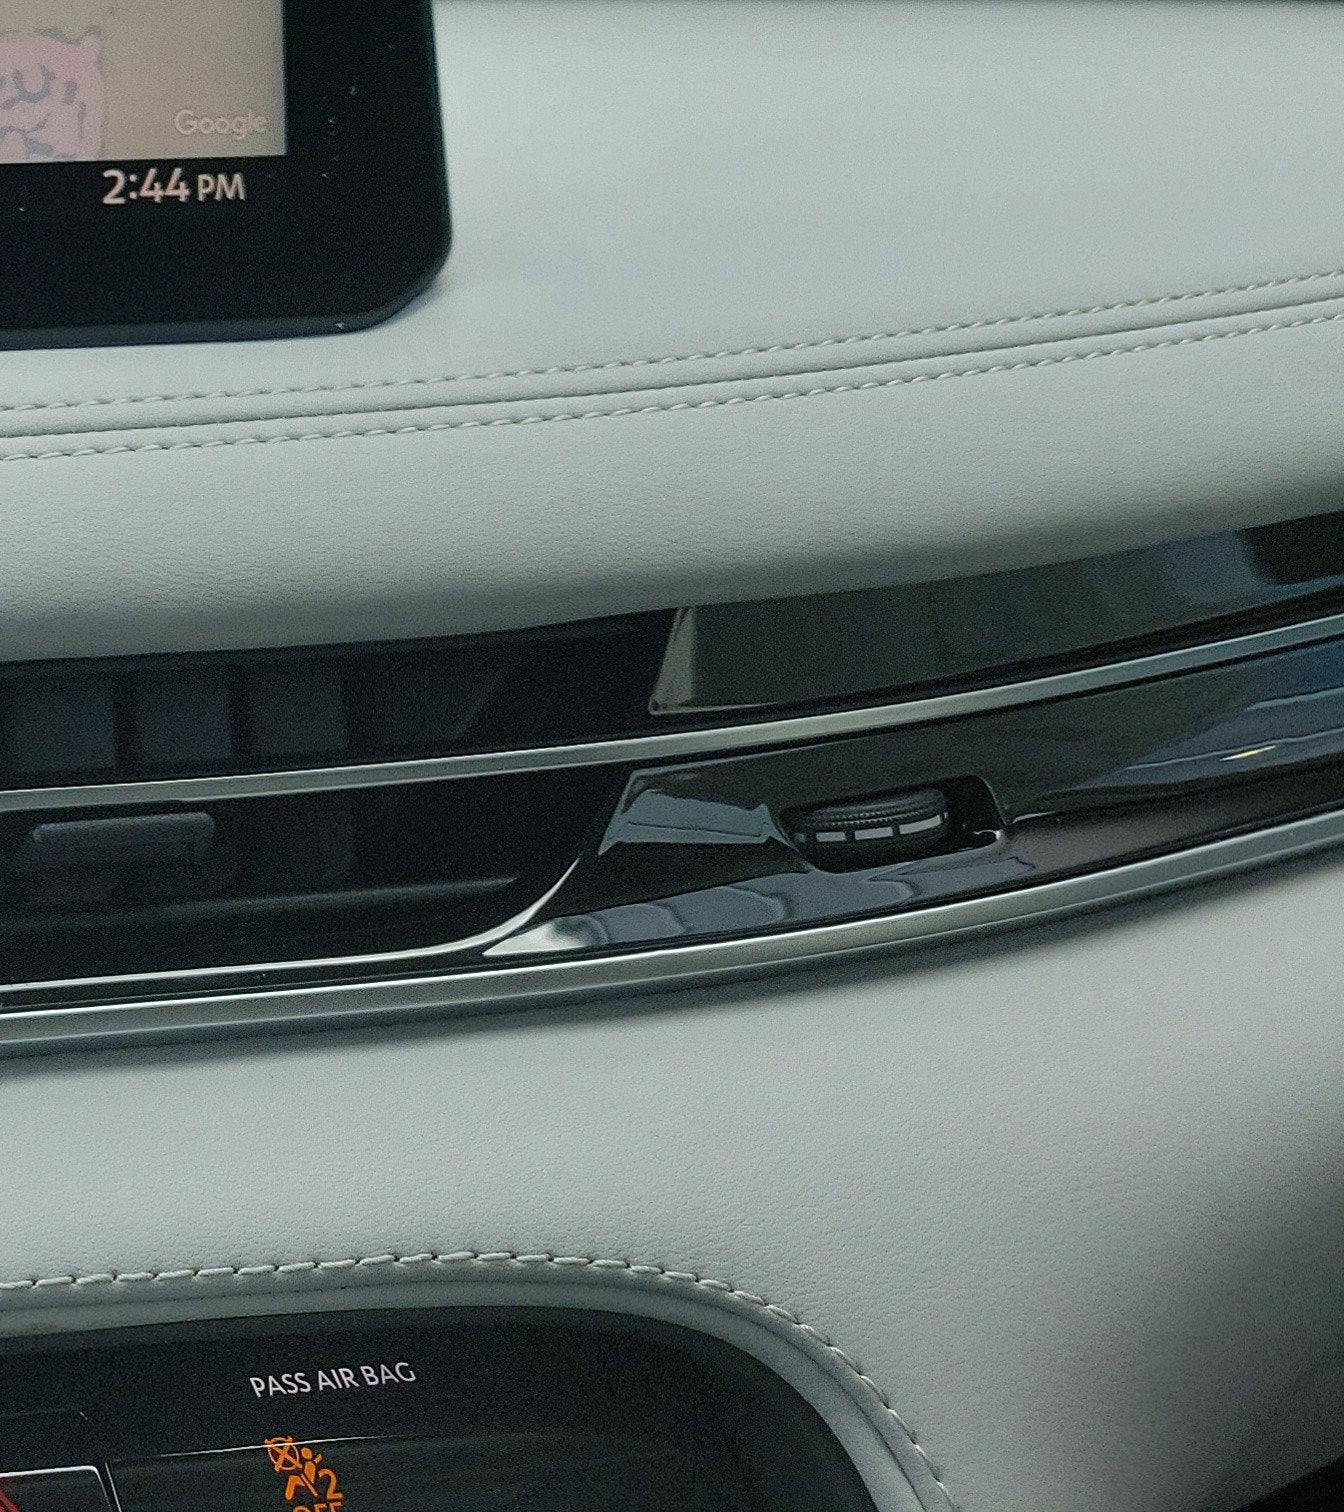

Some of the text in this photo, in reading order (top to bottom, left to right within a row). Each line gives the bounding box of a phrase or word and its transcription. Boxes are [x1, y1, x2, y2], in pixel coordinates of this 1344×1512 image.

[174, 109, 268, 139] Google
[102, 169, 246, 205] 2:44 PM
[249, 1362, 417, 1398] PASS AIR BAG
